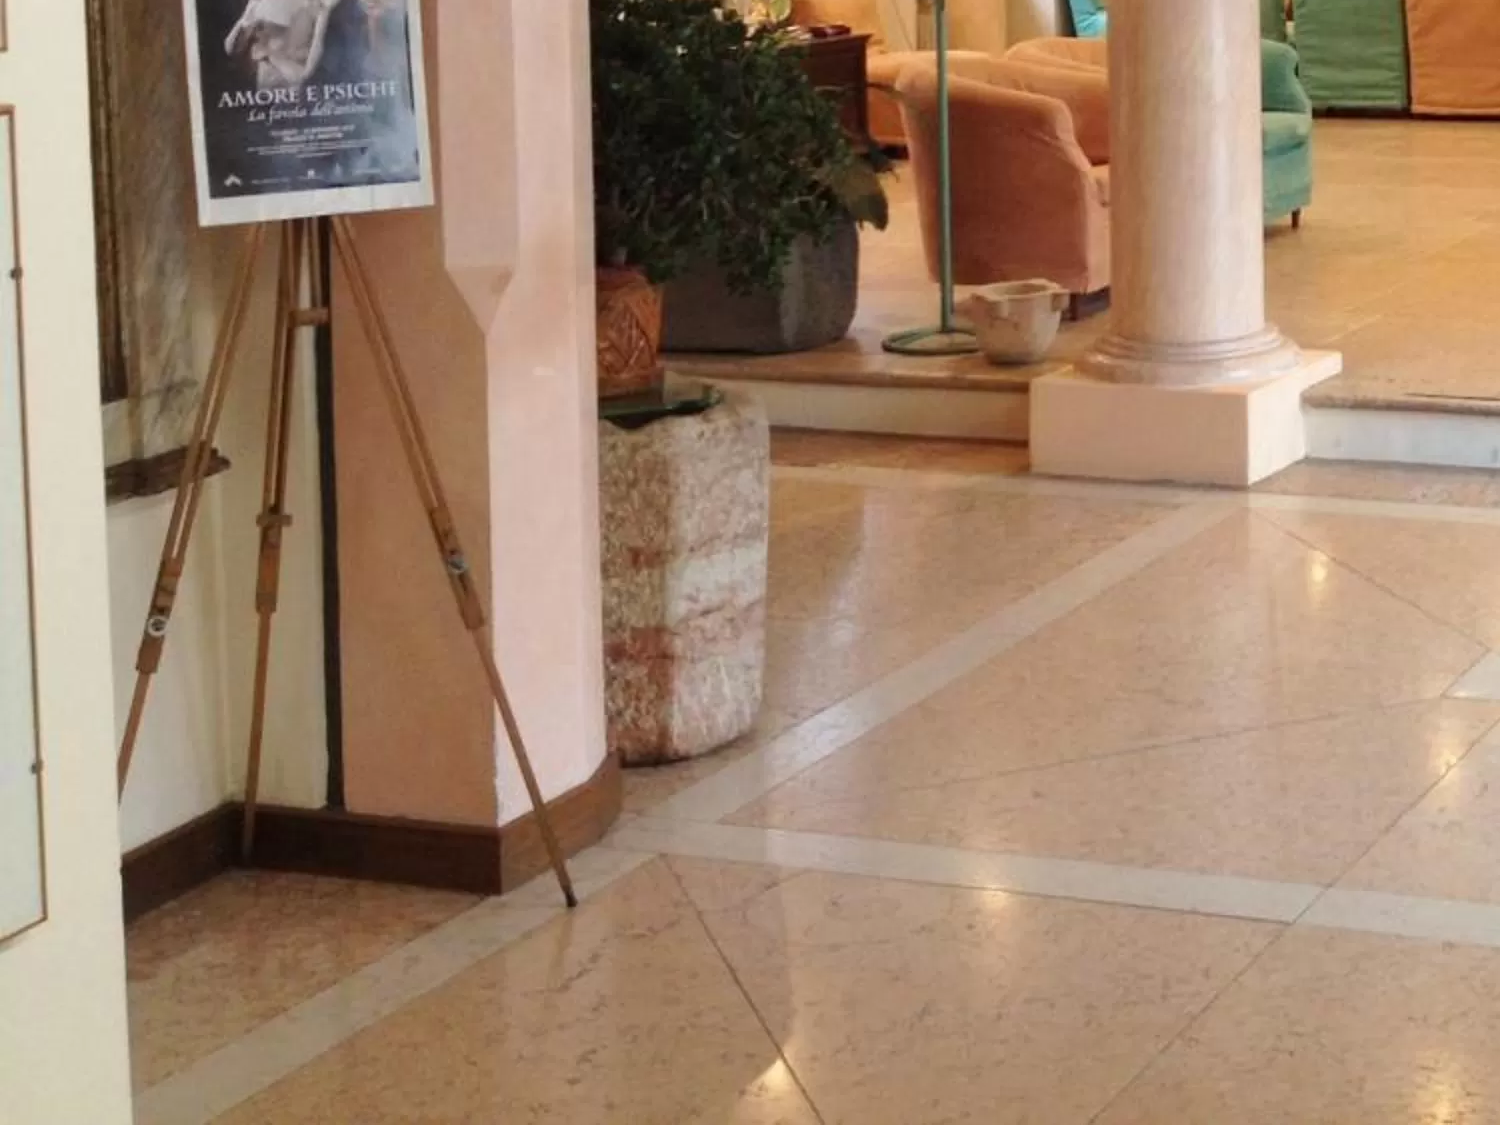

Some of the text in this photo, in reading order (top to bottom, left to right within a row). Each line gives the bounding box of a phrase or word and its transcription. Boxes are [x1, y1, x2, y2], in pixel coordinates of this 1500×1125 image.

[218, 81, 398, 108] AMORE E PSICHE
[247, 108, 265, 122] La
